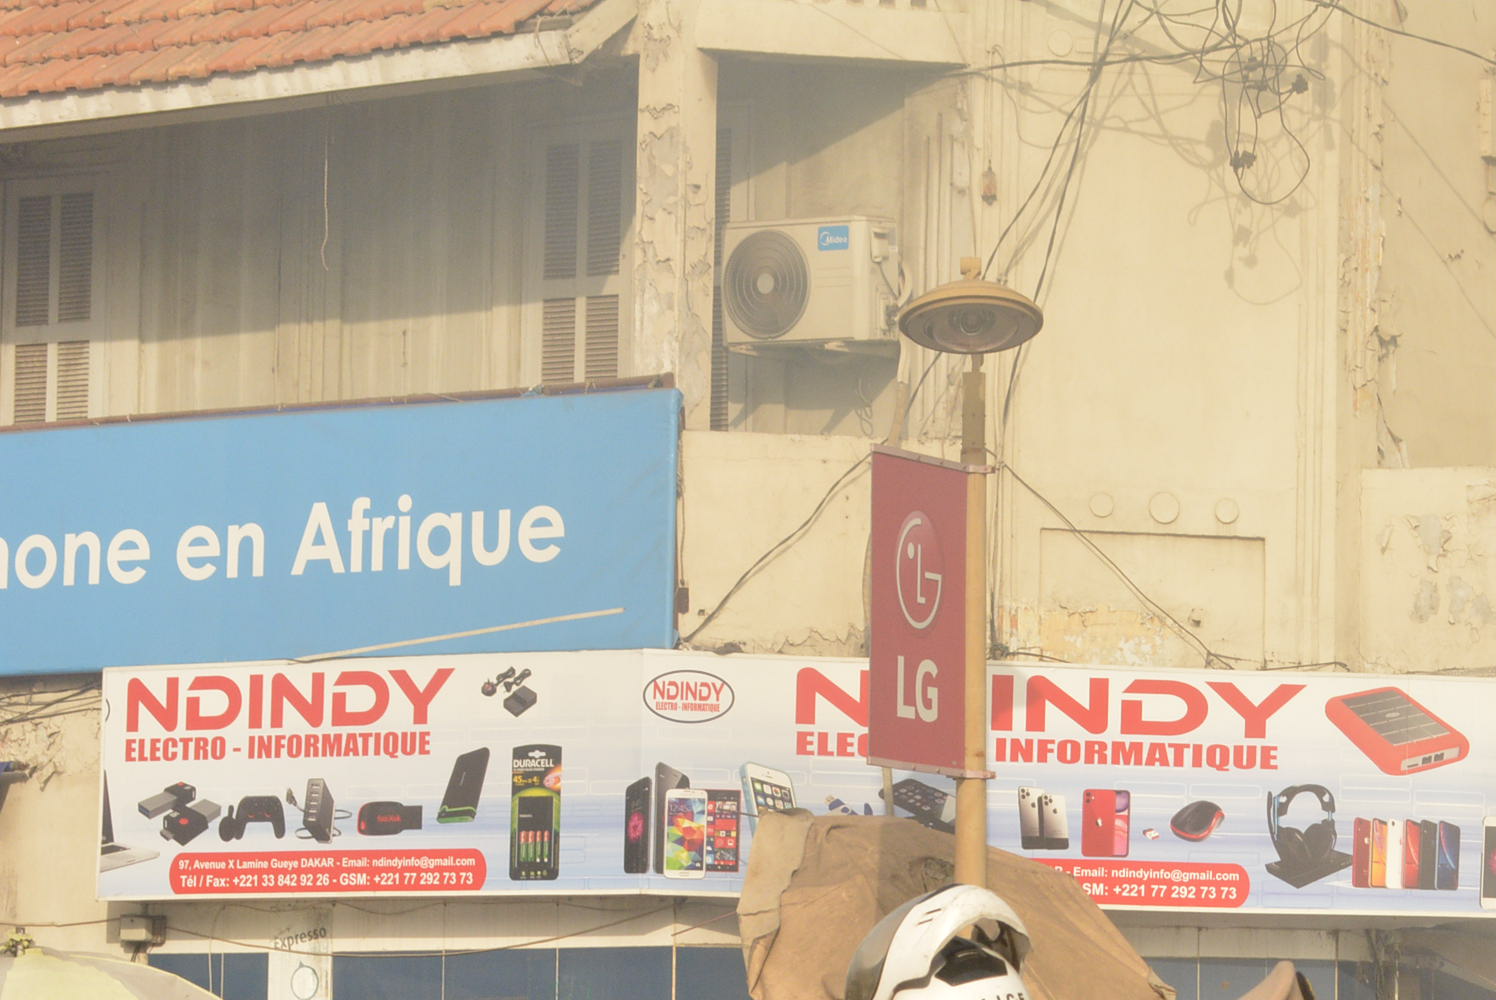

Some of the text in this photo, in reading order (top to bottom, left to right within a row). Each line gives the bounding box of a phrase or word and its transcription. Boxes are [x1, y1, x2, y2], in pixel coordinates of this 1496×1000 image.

[176, 522, 265, 582] en
[290, 494, 566, 587] Afrique
[126, 668, 456, 733] NDINDY
[653, 680, 725, 702] NDINDY
[897, 655, 939, 724] LG
[125, 736, 226, 763] ELECTRO
[248, 731, 431, 759] INFORMATIQUE
[995, 737, 1279, 772] INFORMATIQUE
[513, 759, 554, 769] DURACELL
[178, 859, 191, 871] 97,
[194, 859, 226, 870] Avenue
[228, 859, 235, 869] X
[236, 858, 269, 869] Lamine
[270, 857, 299, 870] Gueye
[301, 857, 334, 868] DAKAR
[342, 856, 370, 868] Email:
[372, 856, 476, 869] ndindyinfo@gmail.com
[1073, 866, 1108, 878] Email:
[1111, 868, 1240, 883] ndindyinfo@gmail.com
[180, 874, 197, 888] Tél
[206, 875, 230, 887] Fax:
[232, 874, 258, 887] +221
[262, 874, 275, 887] 33
[277, 873, 297, 887] 842
[300, 874, 313, 886] 92
[316, 873, 329, 886] 26
[339, 872, 370, 886] GSM:
[373, 872, 400, 886] +221
[403, 872, 417, 885] 77
[419, 872, 440, 885] 292
[443, 872, 457, 885] 73
[460, 872, 474, 885] 73
[1082, 882, 1237, 899] SM: +221 77 292 73 73
